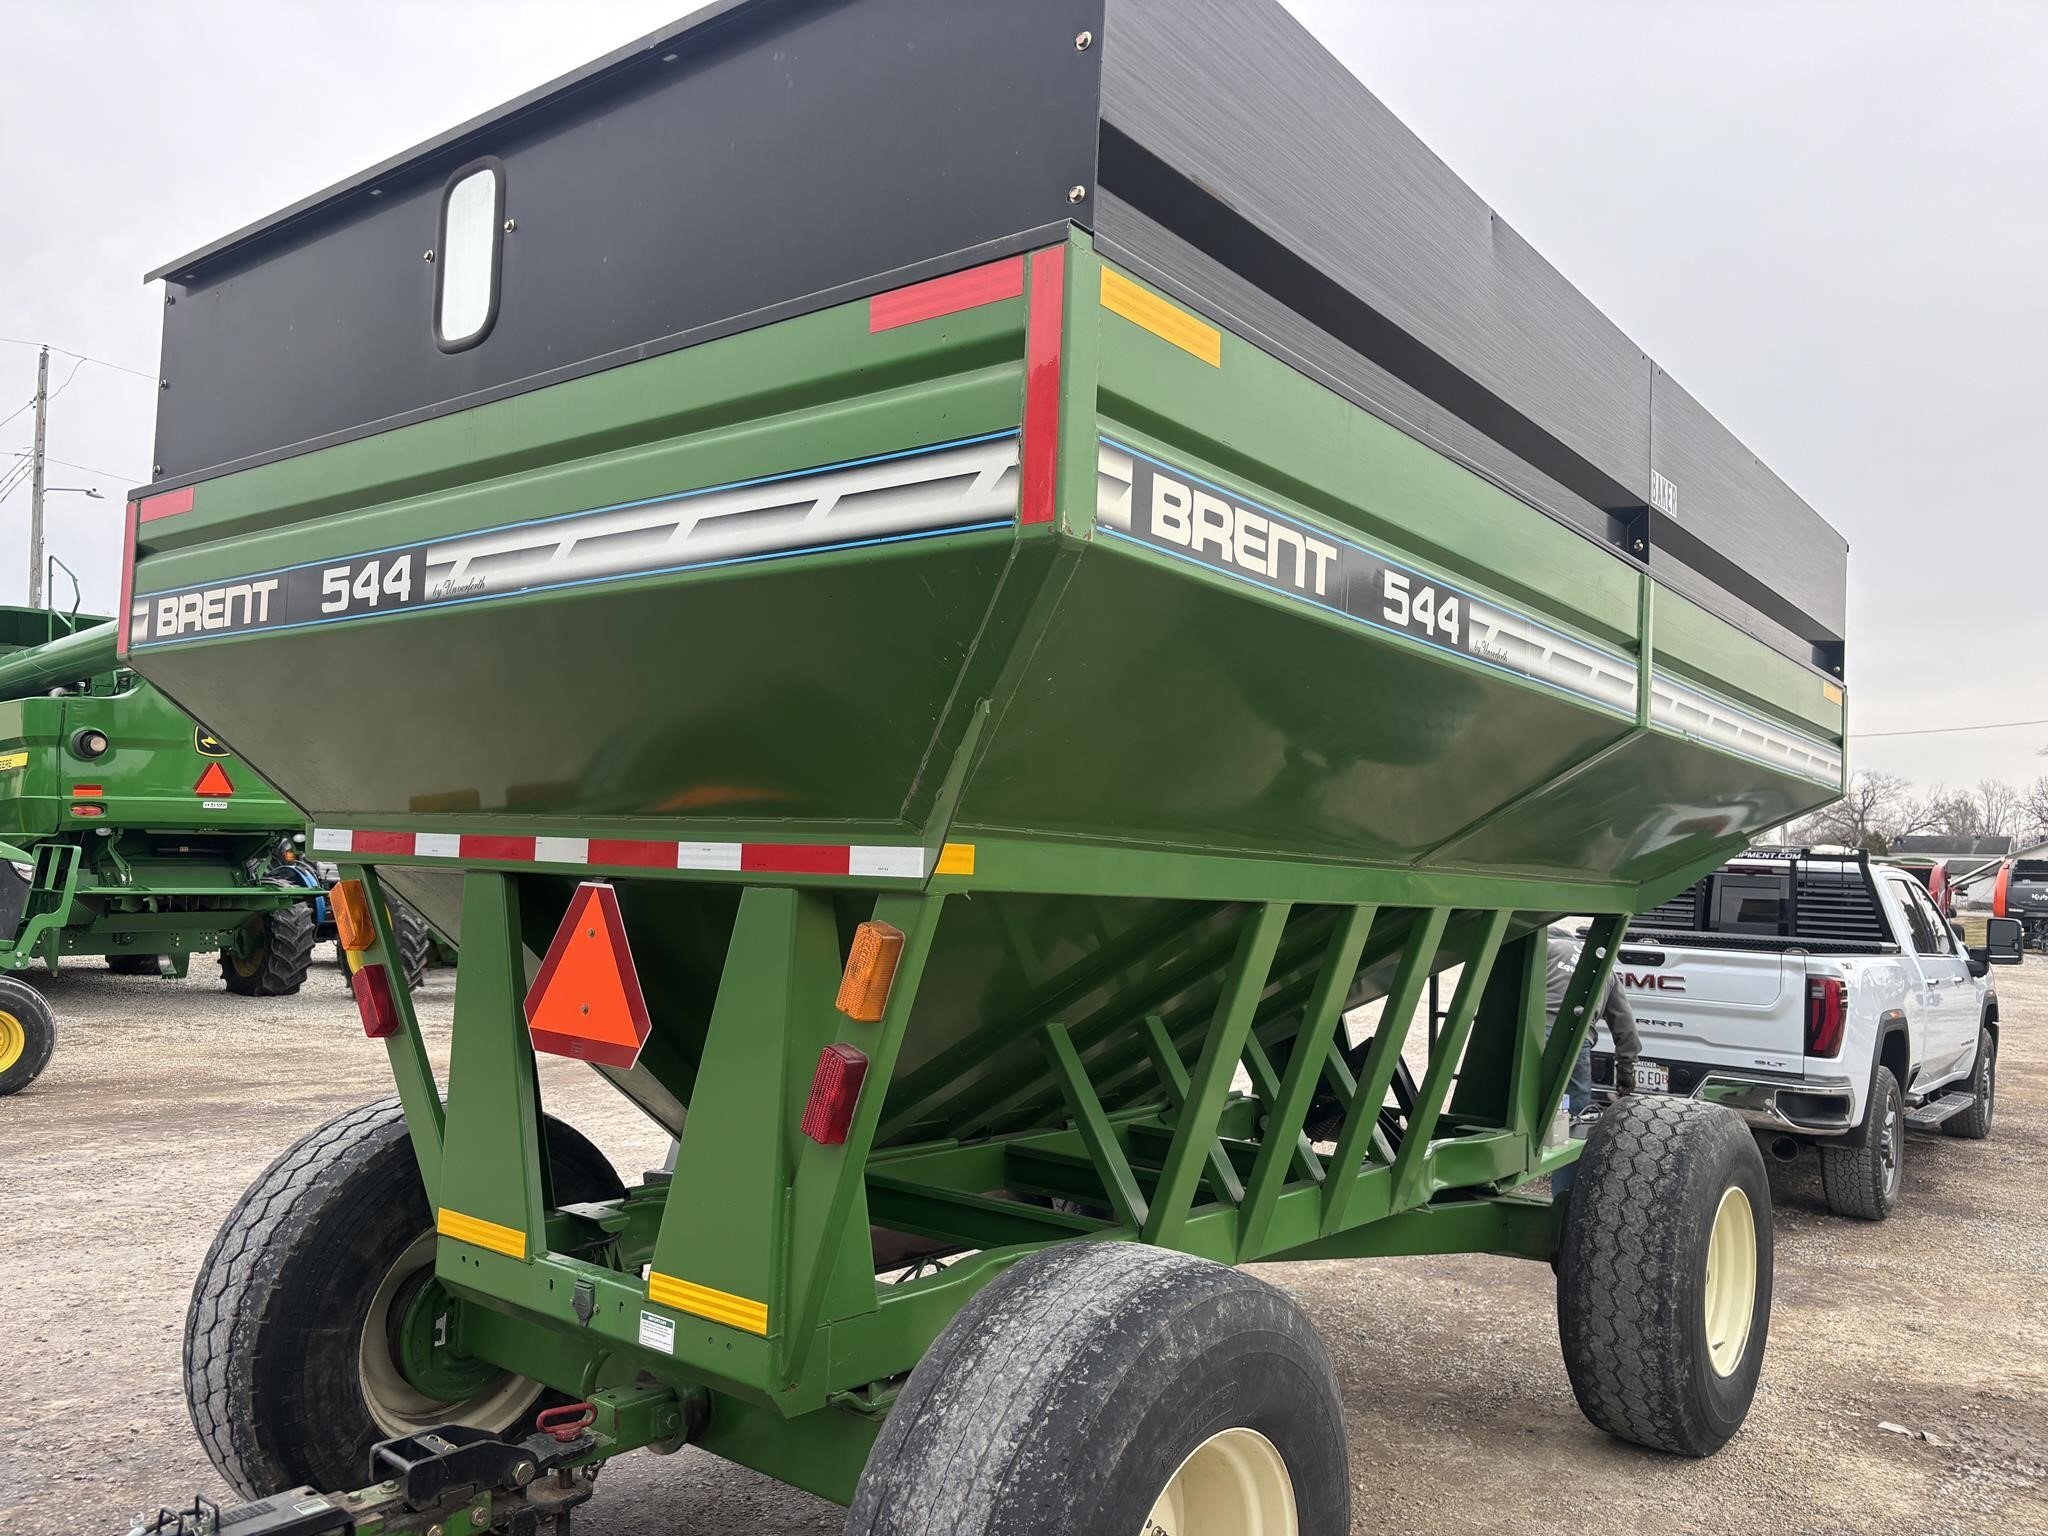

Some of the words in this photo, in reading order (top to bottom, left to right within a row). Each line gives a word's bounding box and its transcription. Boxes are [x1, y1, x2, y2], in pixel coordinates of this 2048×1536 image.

[1651, 470, 1677, 517] BAKER
[1151, 473, 1338, 597] BRENT
[1382, 568, 1460, 645] 544
[156, 578, 279, 638] BRENT
[321, 555, 412, 614] 544
[1736, 852, 1801, 860] IPMENT.COM
